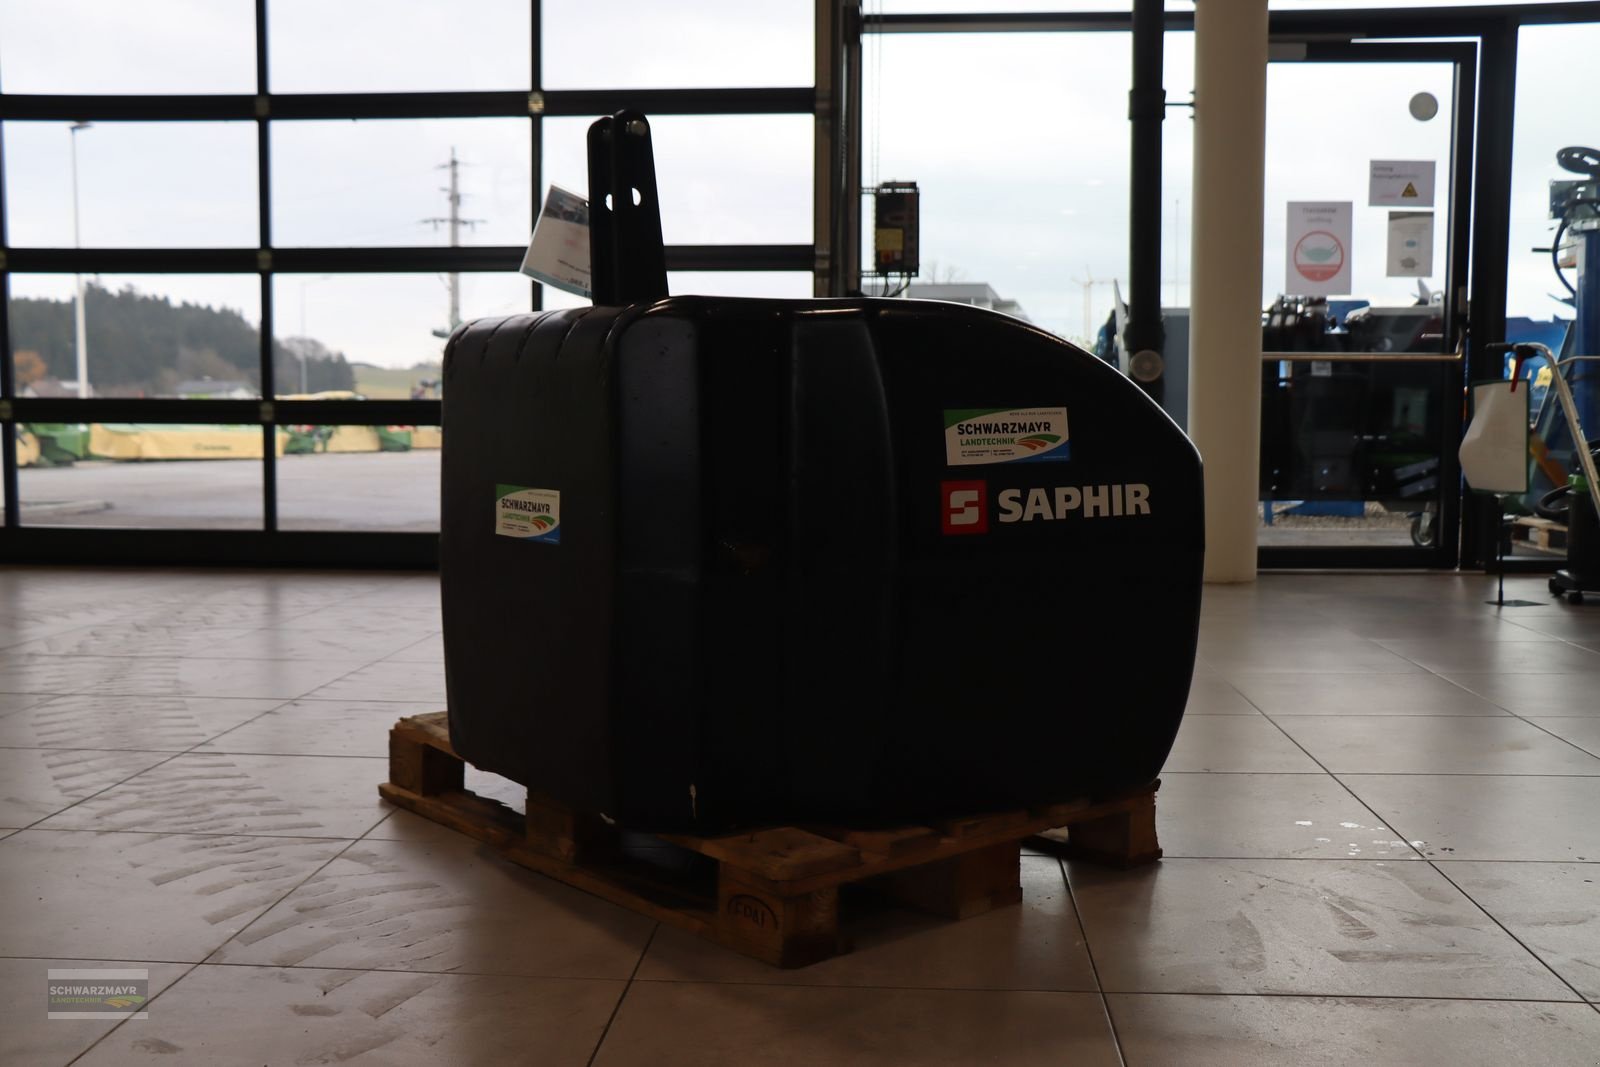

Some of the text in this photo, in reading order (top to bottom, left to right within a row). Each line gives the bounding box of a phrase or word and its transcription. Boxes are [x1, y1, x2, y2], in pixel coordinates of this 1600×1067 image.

[957, 421, 1051, 436] SCHWARZMAYR
[960, 437, 1016, 447] LANDTECHNIK
[501, 498, 551, 514] SCHWARZMAYR
[998, 483, 1151, 523] SAPHIR
